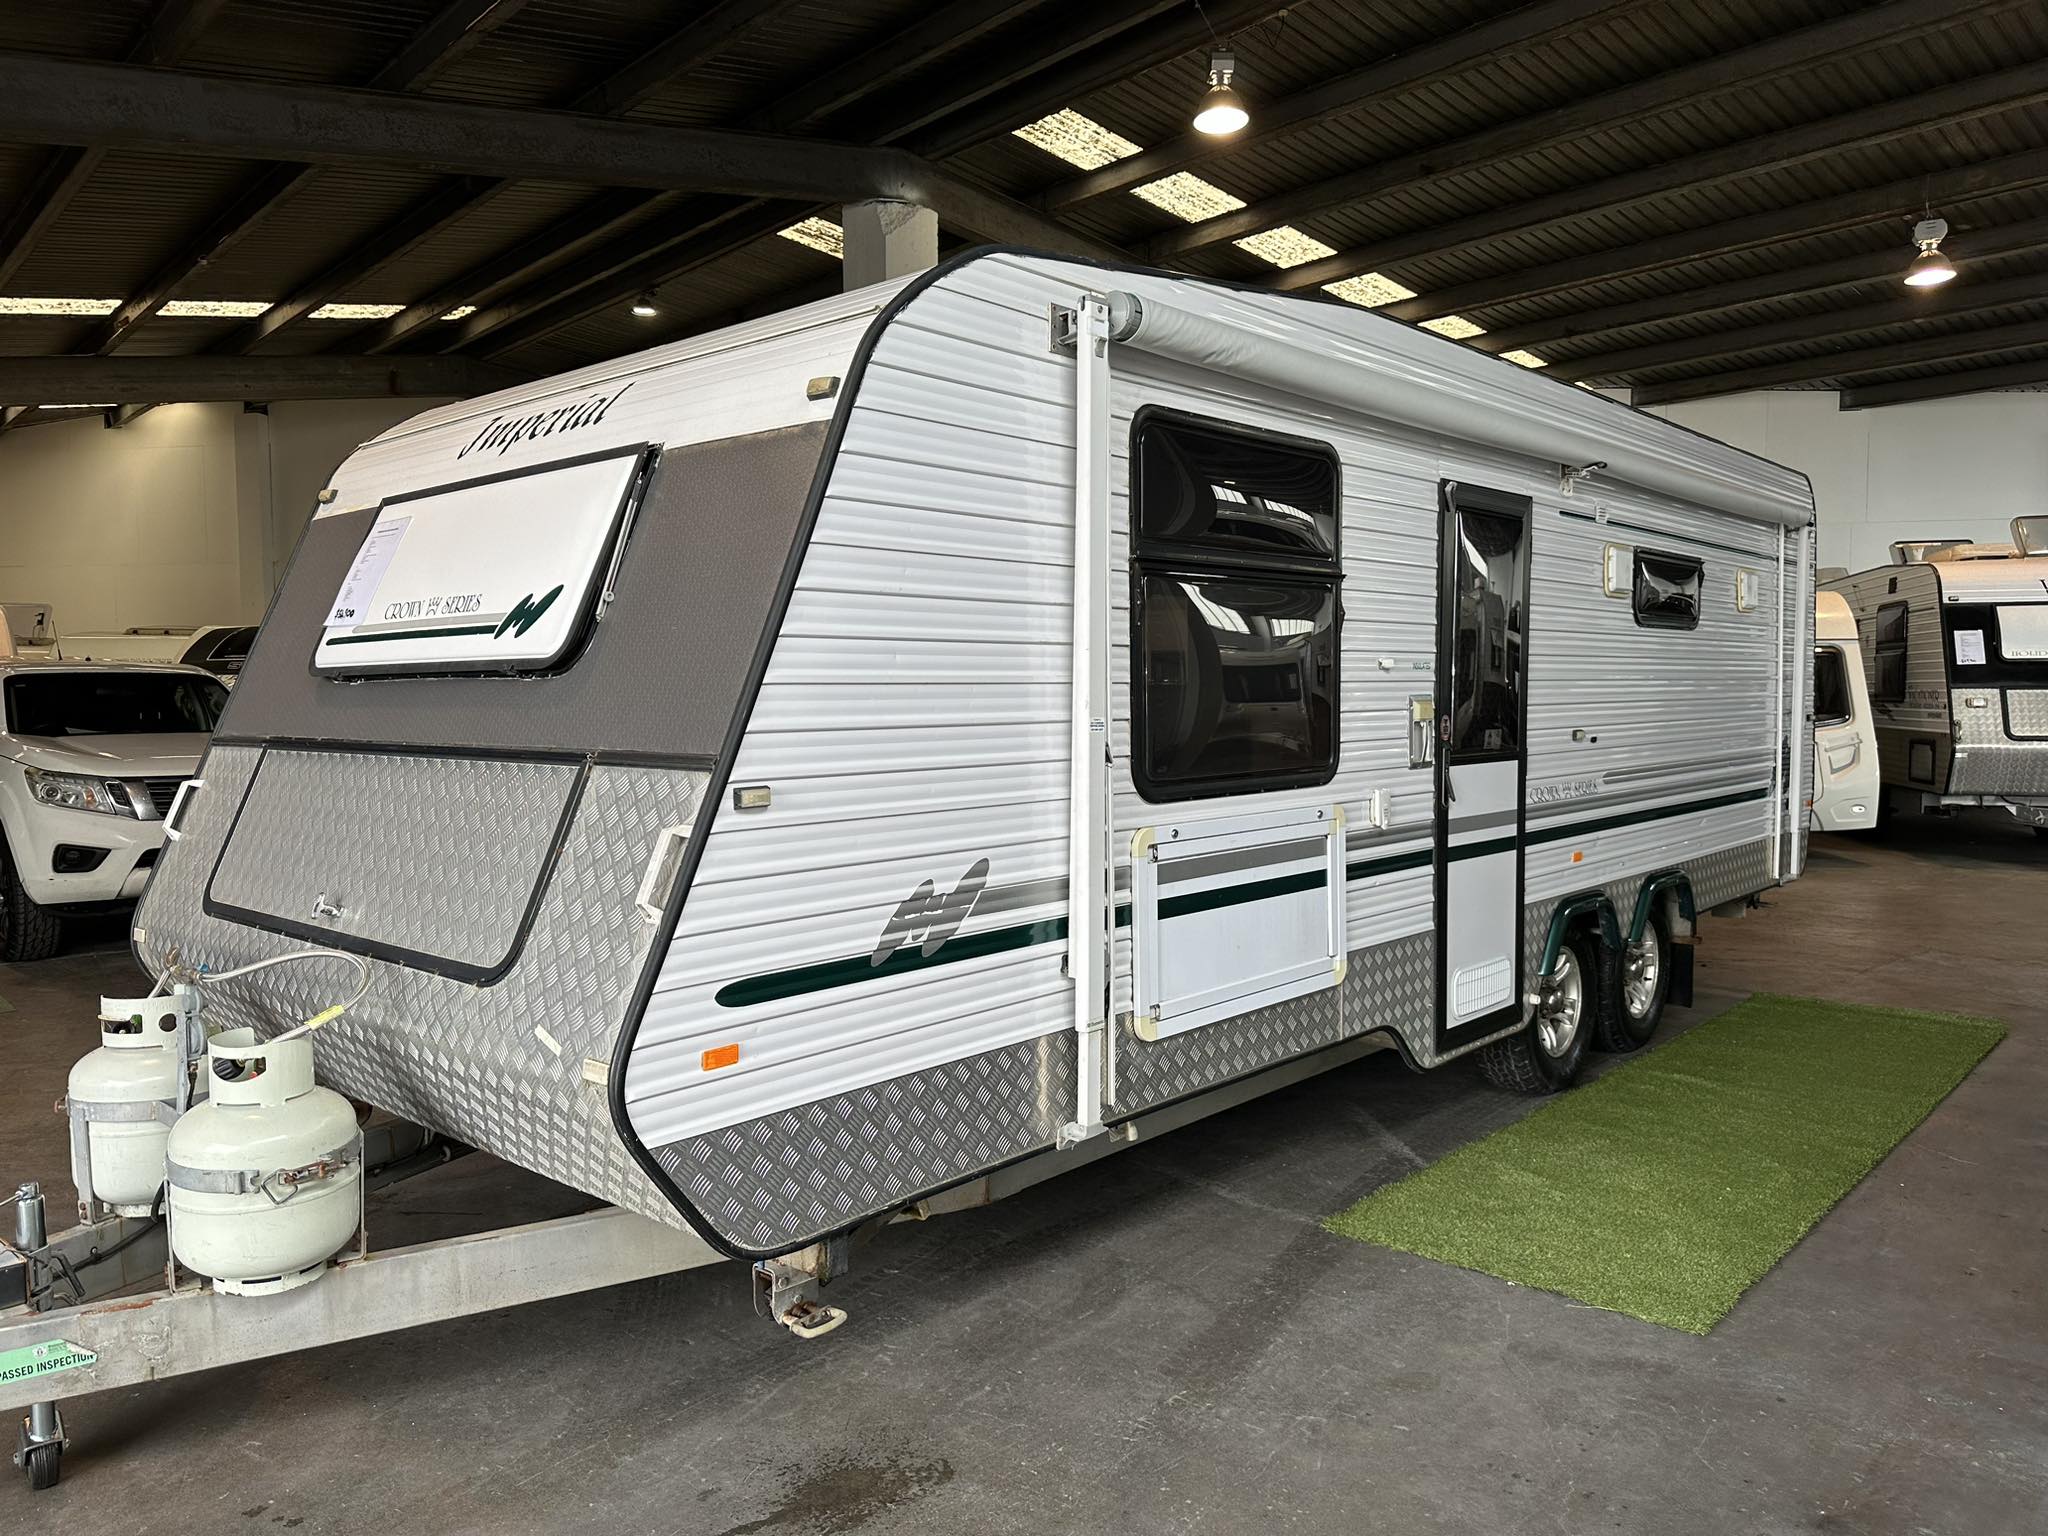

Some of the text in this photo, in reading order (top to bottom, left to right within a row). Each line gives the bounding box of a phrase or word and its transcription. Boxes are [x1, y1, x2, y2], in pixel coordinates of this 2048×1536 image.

[457, 380, 637, 460] Imperial
[384, 594, 483, 620] CROWN SERIES
[0, 1364, 34, 1381] ASSED
